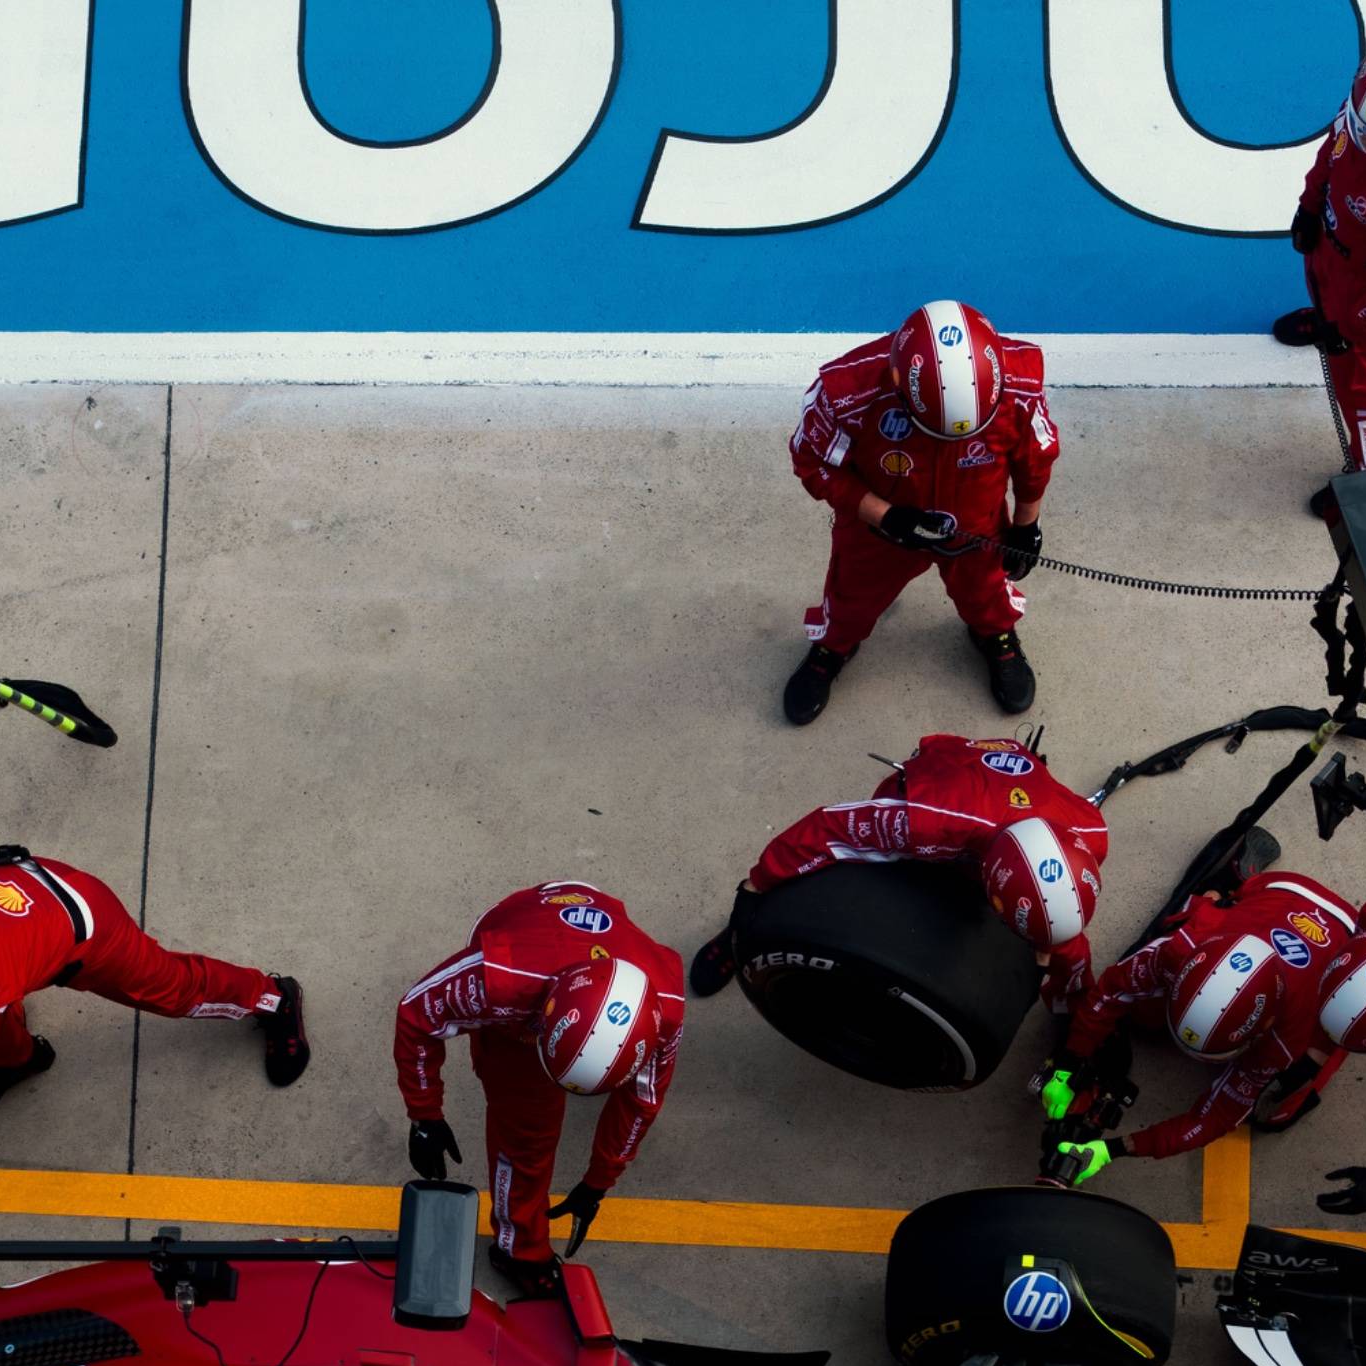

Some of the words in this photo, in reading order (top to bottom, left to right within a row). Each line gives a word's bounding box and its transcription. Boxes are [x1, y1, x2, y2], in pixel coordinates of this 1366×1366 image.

[939, 326, 963, 346] hp
[880, 409, 913, 440] hp
[985, 752, 1032, 775] hp
[1039, 858, 1062, 882] hp
[561, 907, 611, 932] hp
[1272, 928, 1311, 968] hp
[751, 951, 836, 971] ZERO
[1230, 952, 1253, 973] hp
[607, 1001, 630, 1026] hp
[1004, 1272, 1071, 1332] hp
